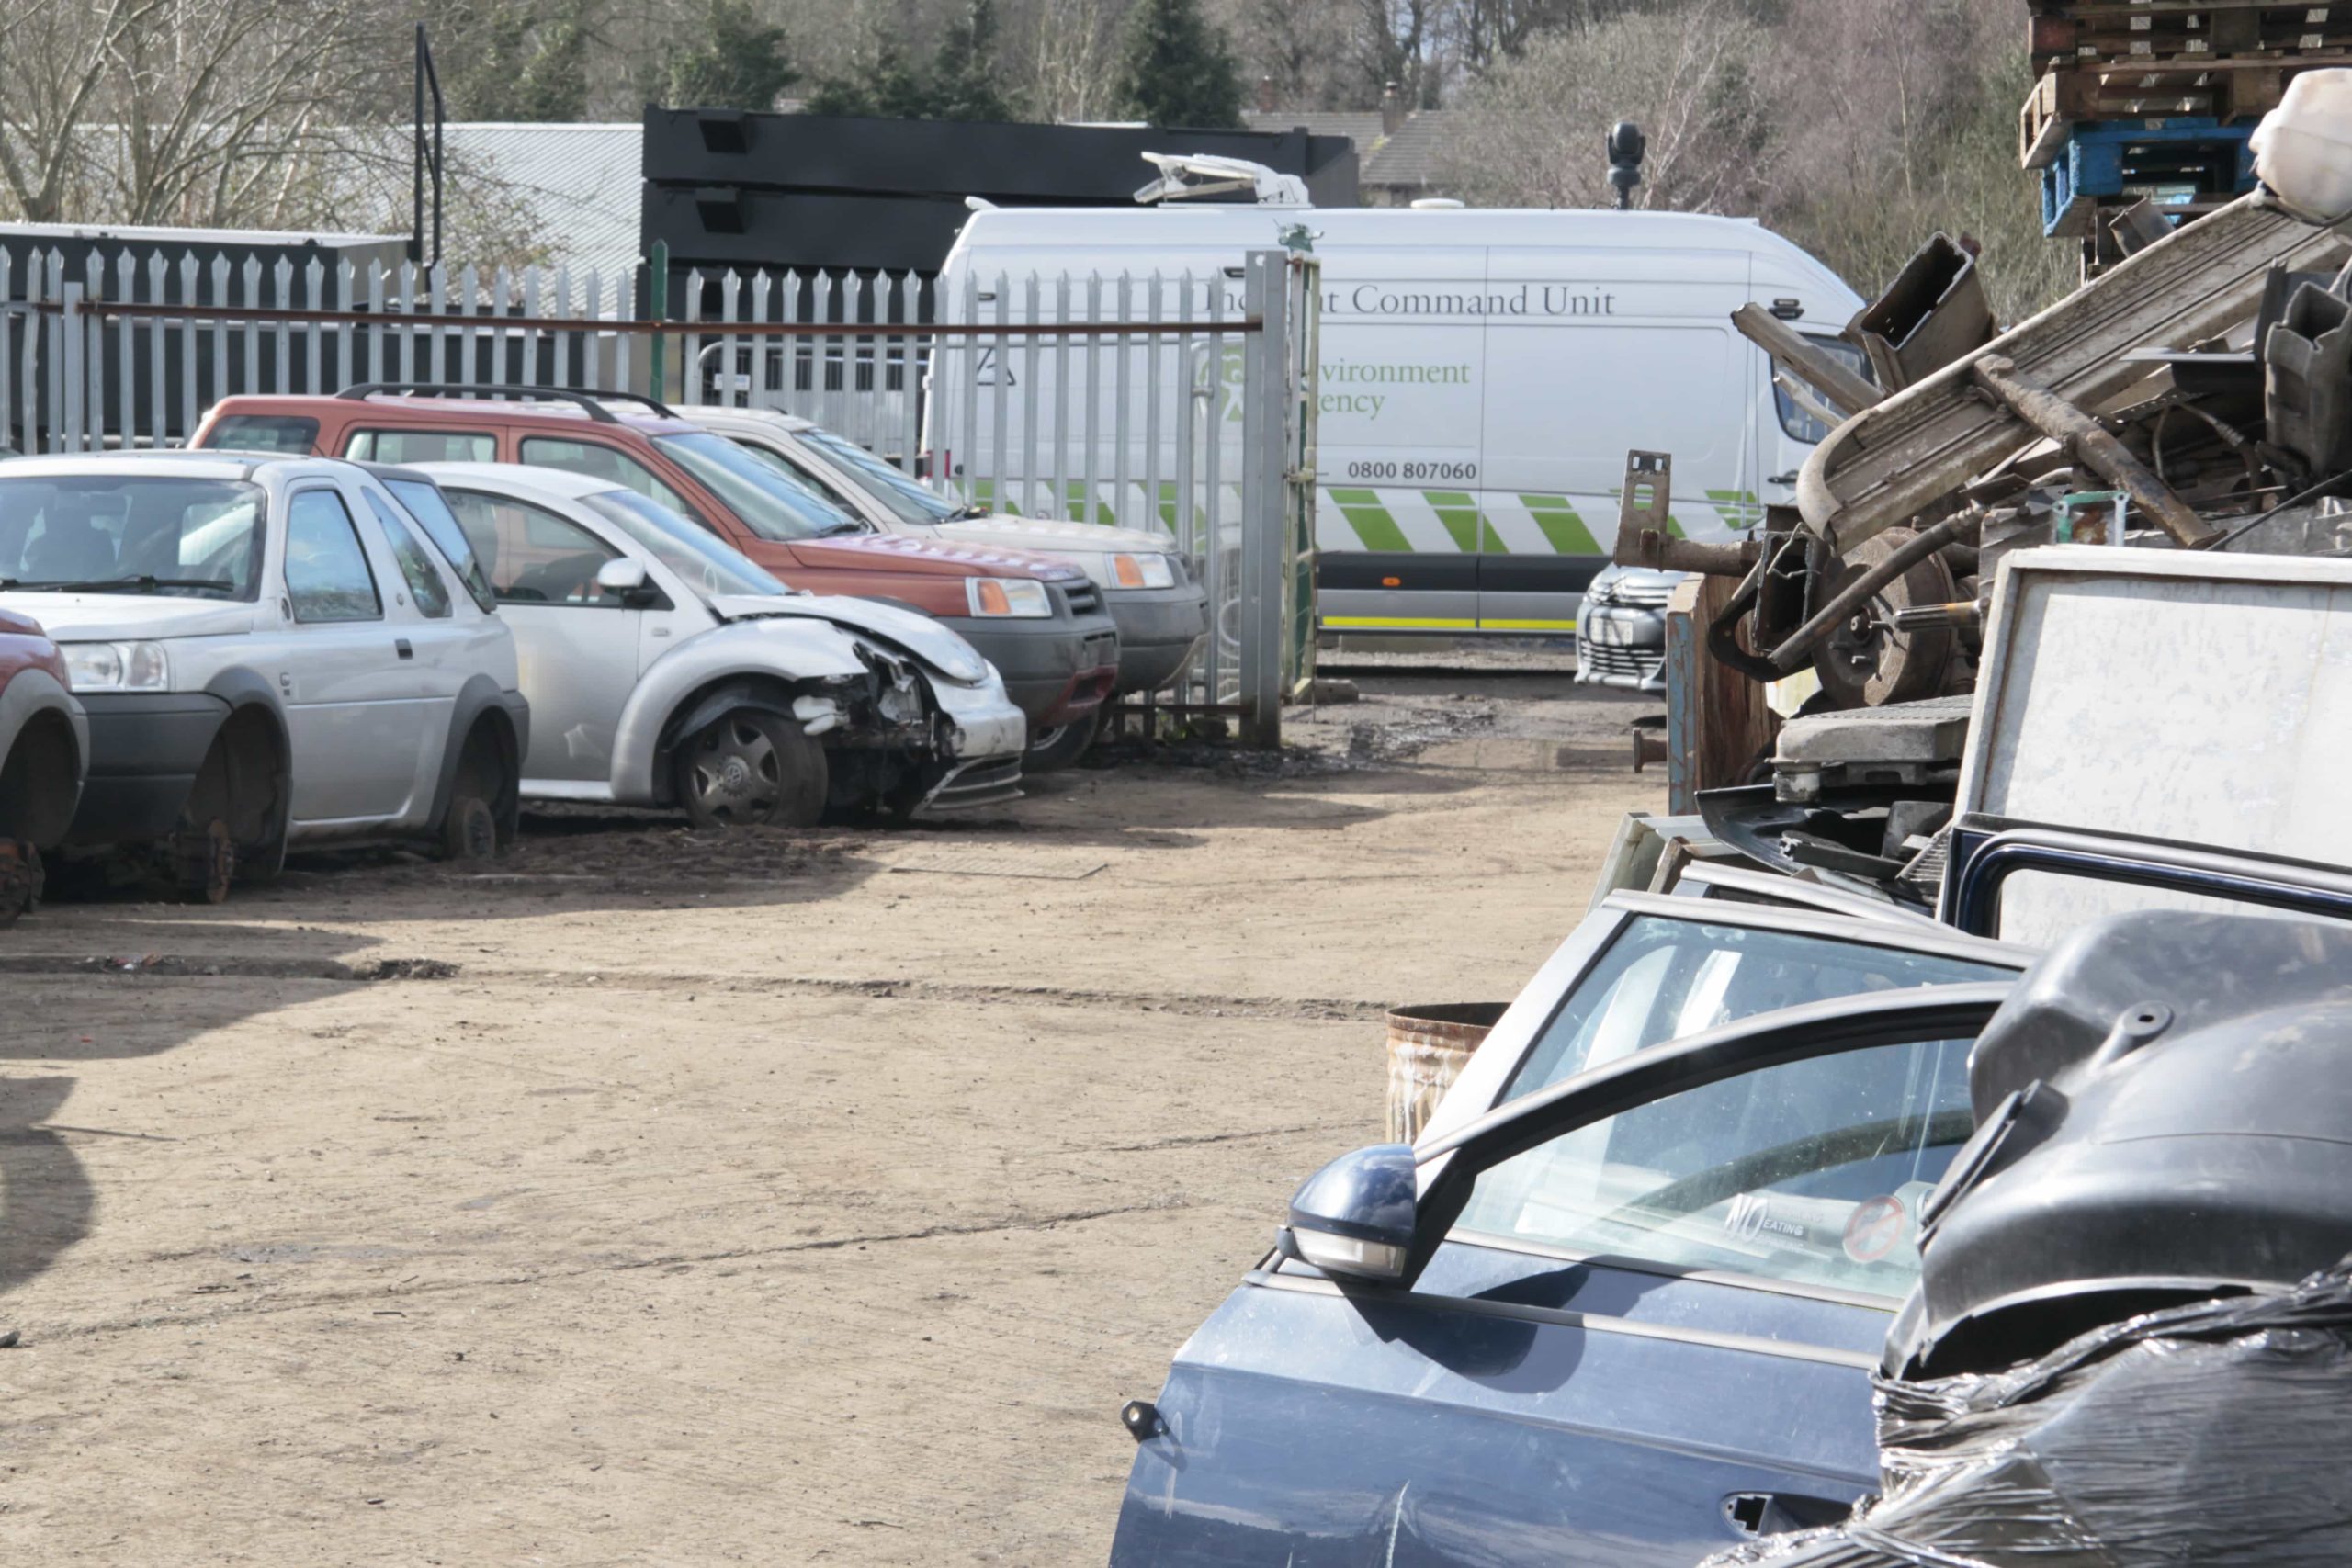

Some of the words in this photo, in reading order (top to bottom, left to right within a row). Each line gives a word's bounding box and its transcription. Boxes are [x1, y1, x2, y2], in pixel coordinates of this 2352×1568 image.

[1351, 284, 1528, 315] Command
[1542, 286, 1615, 315] Unit
[1318, 357, 1471, 384] vironment
[1318, 393, 1385, 421] ency
[1347, 461, 1397, 479] 0800
[1402, 462, 1477, 480] 807060
[1724, 1192, 1769, 1243] NO
[1763, 1219, 1804, 1236] EATING
